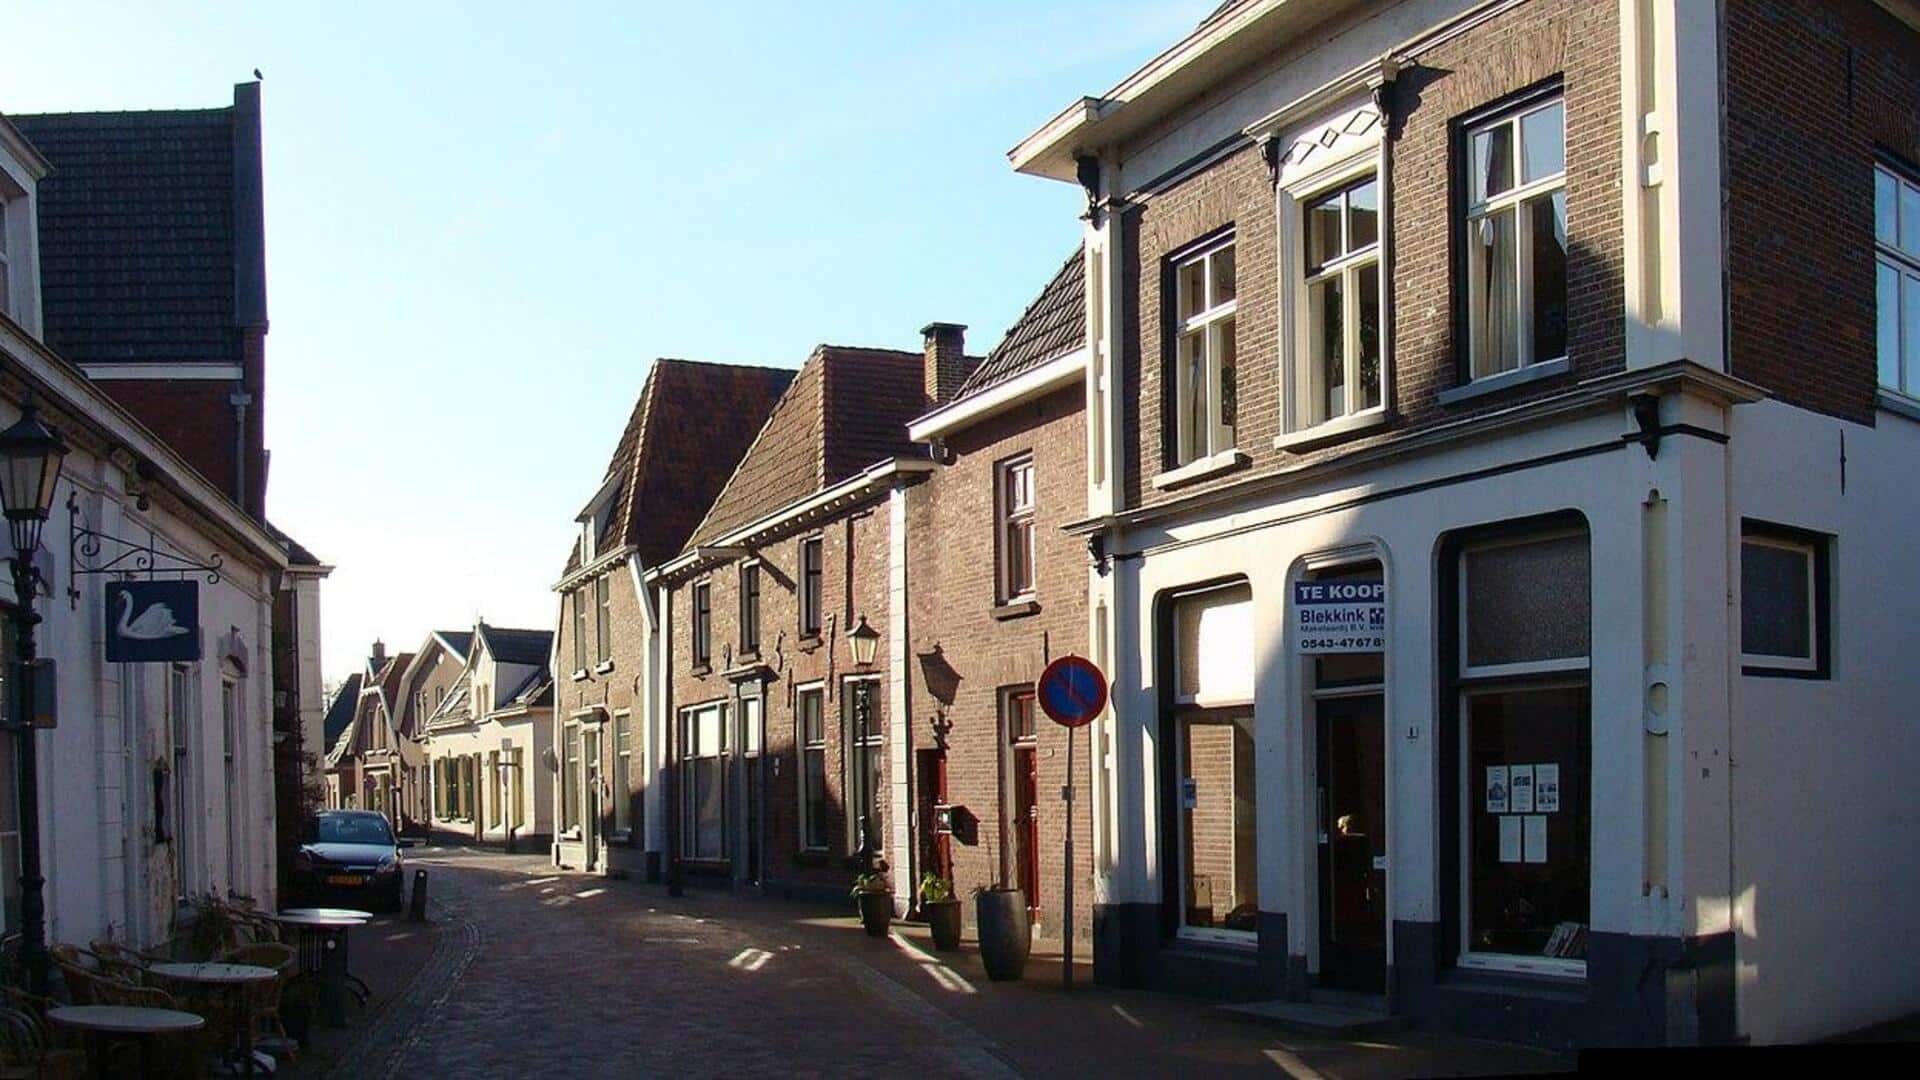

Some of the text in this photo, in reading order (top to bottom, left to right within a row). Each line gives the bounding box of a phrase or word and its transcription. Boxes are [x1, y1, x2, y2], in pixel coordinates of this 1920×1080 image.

[1300, 584, 1384, 600] TE KOOP
[1300, 608, 1365, 624] Blekkink
